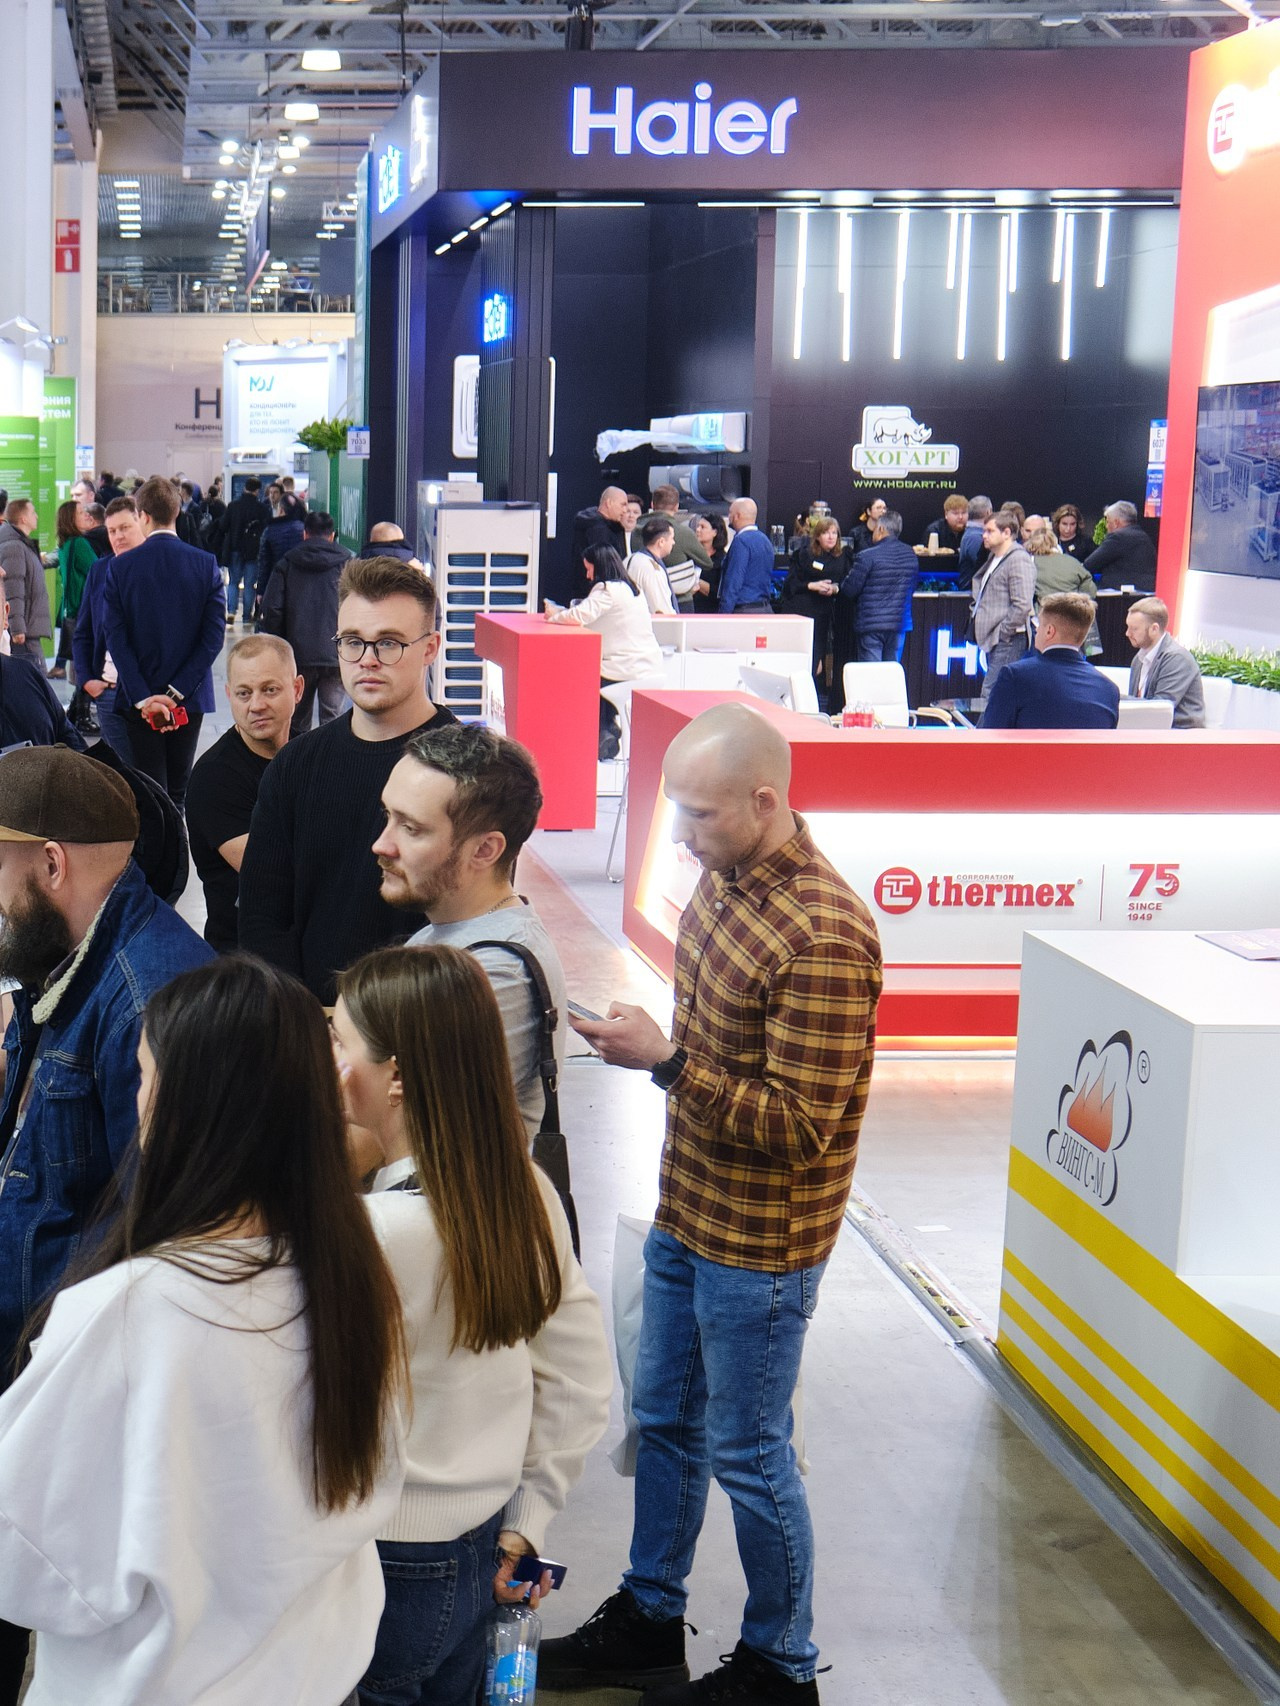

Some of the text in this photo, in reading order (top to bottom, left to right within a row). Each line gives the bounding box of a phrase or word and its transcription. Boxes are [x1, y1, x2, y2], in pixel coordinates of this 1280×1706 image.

[572, 82, 798, 155] Haier
[863, 450, 951, 466] ХОГАРТ
[853, 480, 957, 489] WWW.HOGART.RU
[936, 629, 988, 675] H
[927, 875, 1075, 907] thermex
[1128, 863, 1180, 897] 75
[1127, 913, 1153, 921] 1949
[1128, 902, 1163, 911] SINCE
[1056, 1131, 1106, 1199] ВИНГС-М
